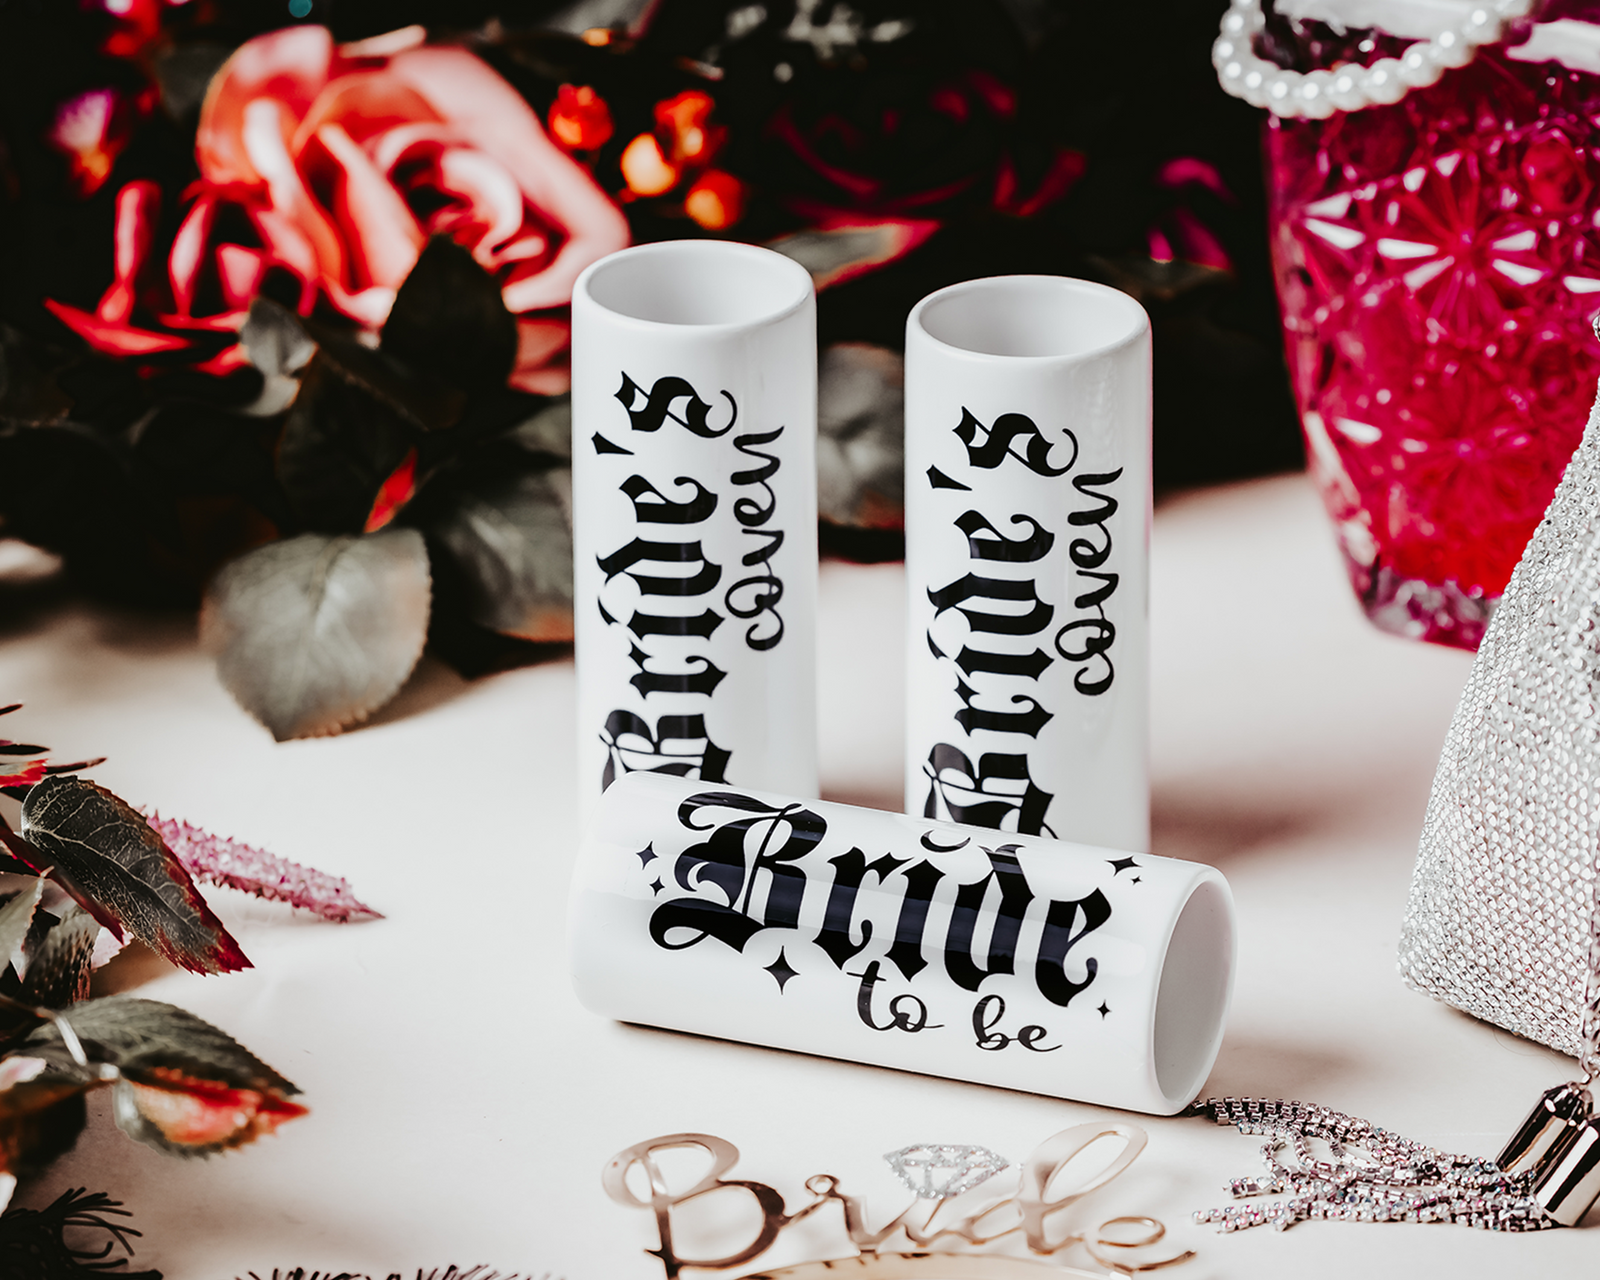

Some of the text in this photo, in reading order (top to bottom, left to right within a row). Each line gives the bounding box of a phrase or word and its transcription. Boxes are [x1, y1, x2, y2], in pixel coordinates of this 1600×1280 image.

[724, 425, 785, 651] coven
[1056, 466, 1123, 695] coven
[649, 791, 1112, 1007] Bride
[847, 961, 1064, 1051] to be
[602, 1122, 1198, 1280] Bride
